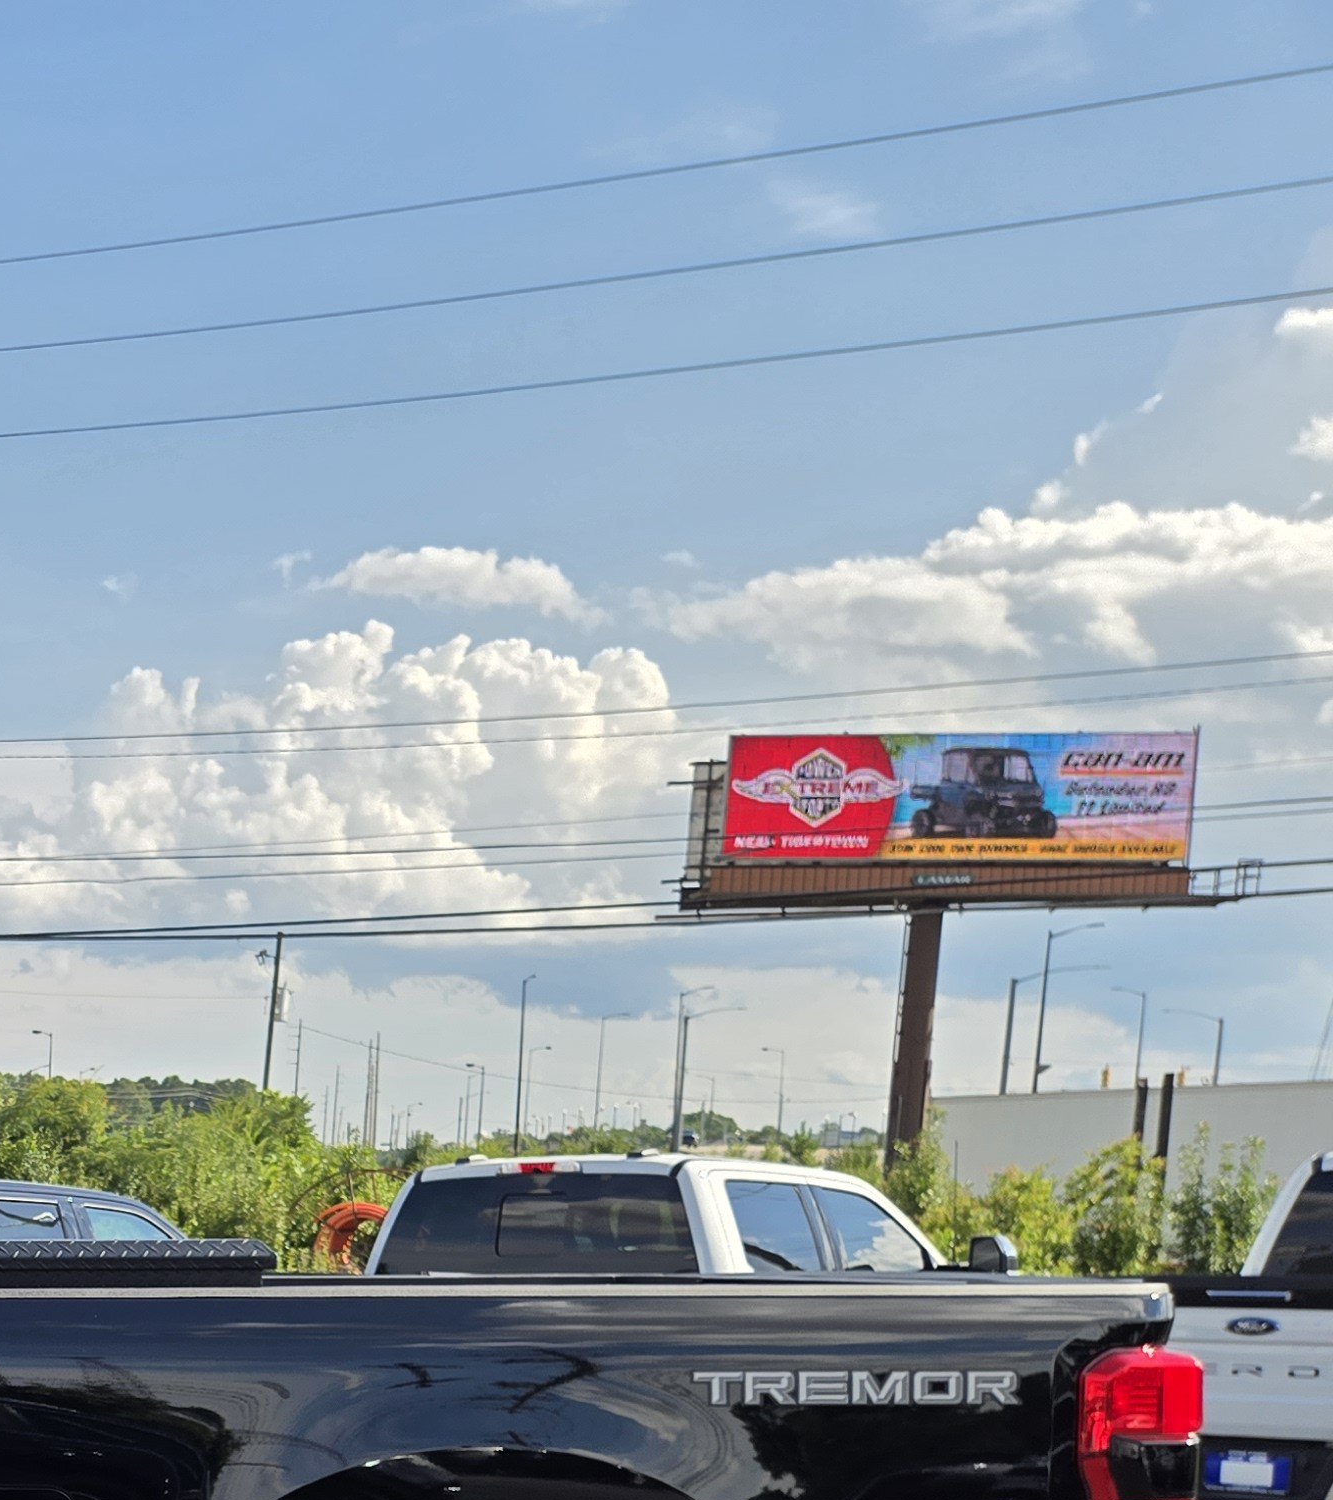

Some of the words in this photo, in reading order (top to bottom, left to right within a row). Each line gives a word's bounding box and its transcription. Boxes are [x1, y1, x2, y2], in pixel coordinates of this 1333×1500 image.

[1062, 752, 1185, 769] can-am
[762, 780, 879, 796] EXTREME
[693, 1371, 1022, 1405] TREMOR
